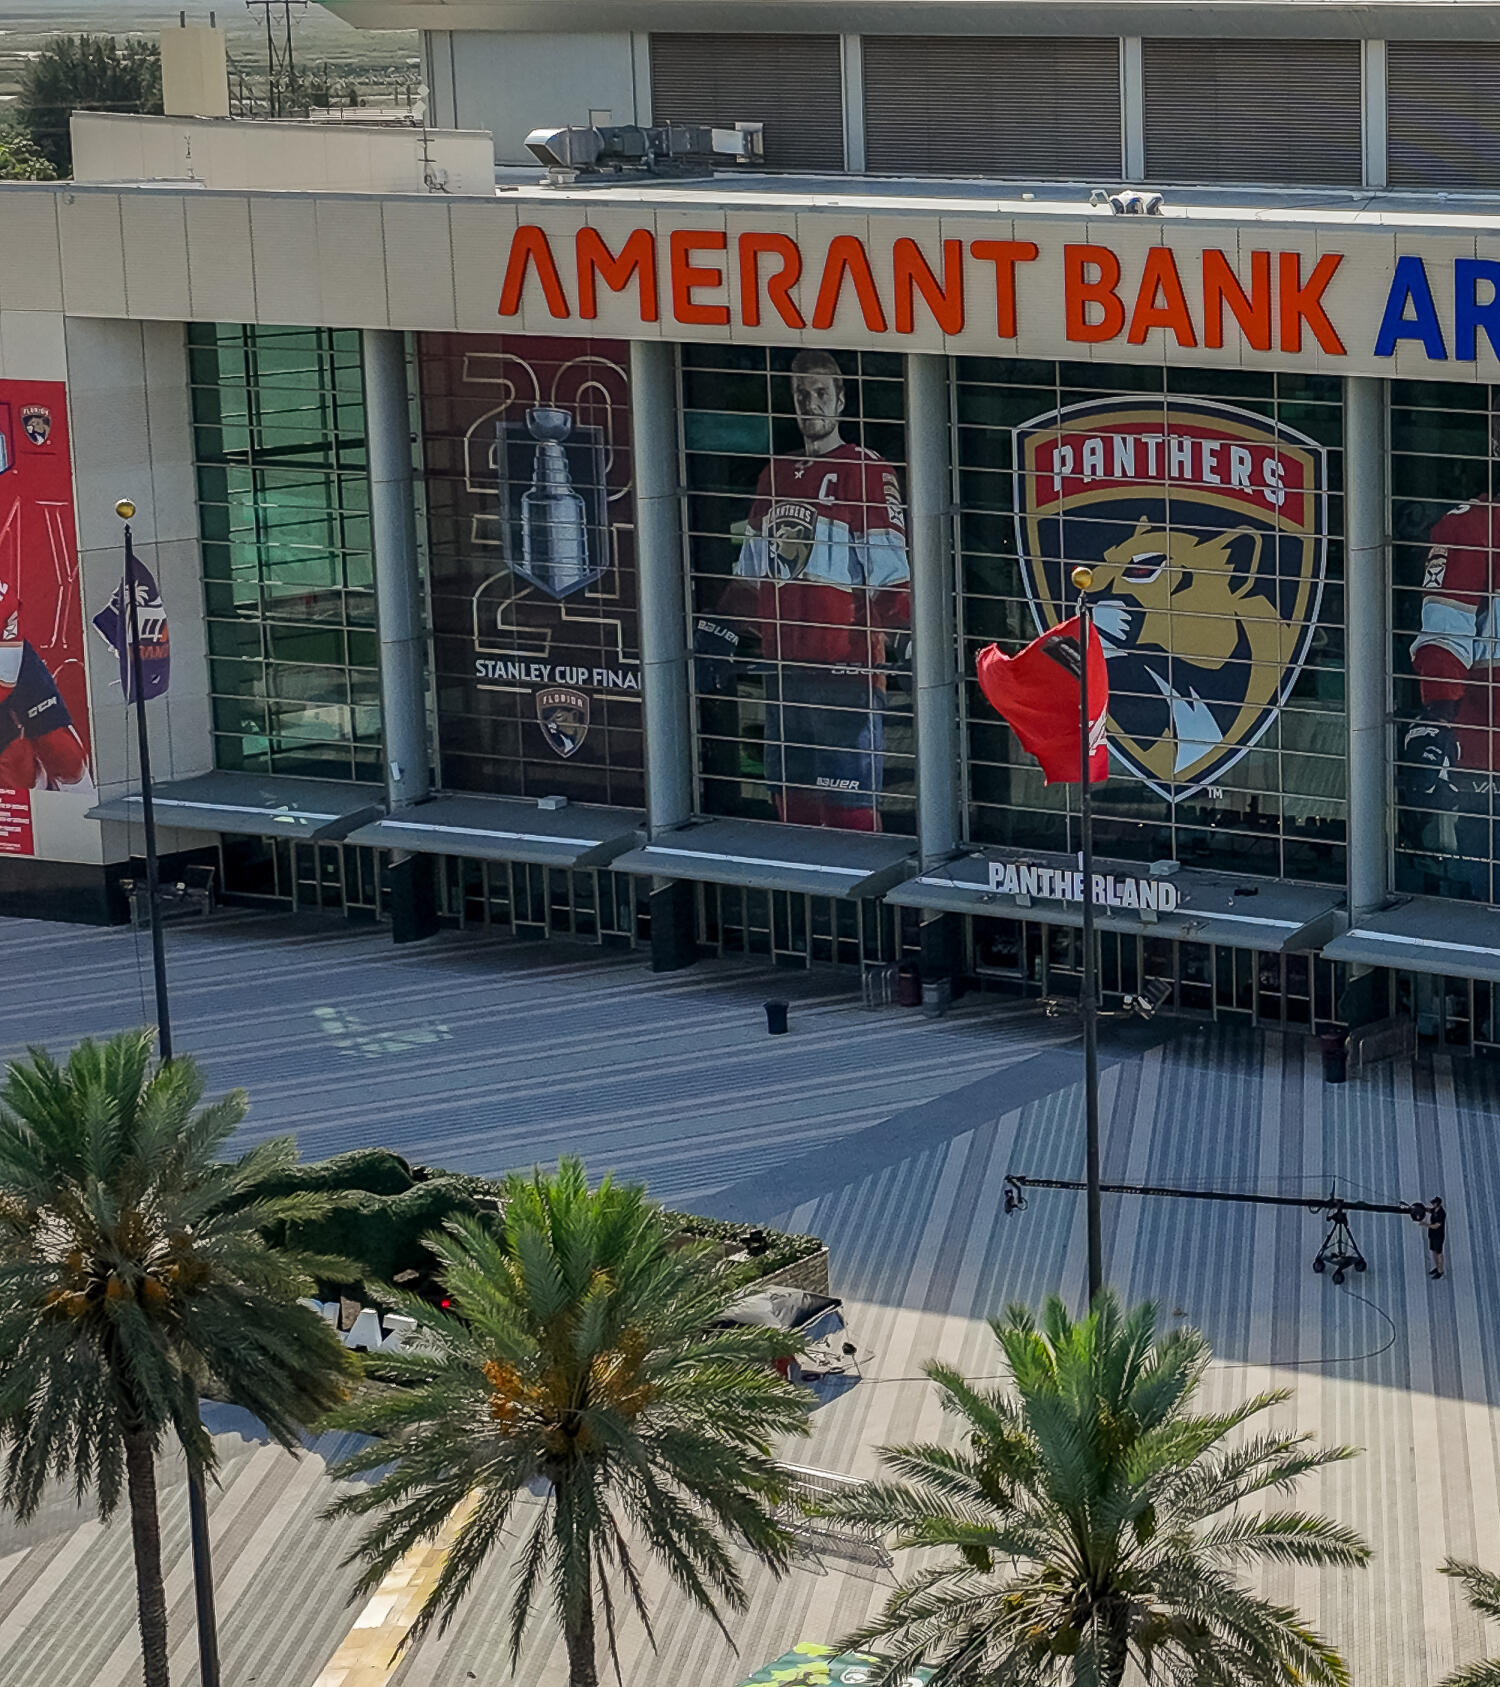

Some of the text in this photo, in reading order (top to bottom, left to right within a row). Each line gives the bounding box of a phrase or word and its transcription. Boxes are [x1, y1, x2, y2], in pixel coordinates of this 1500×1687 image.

[498, 224, 1039, 339] AMERANT
[1063, 243, 1348, 356] BANK
[818, 473, 838, 506] C
[1052, 433, 1286, 507] PANTHERS
[475, 659, 551, 682] STANLEY
[555, 666, 589, 686] CUP
[1207, 787, 1223, 800] TM
[988, 861, 1180, 912] PANTHERLAND
